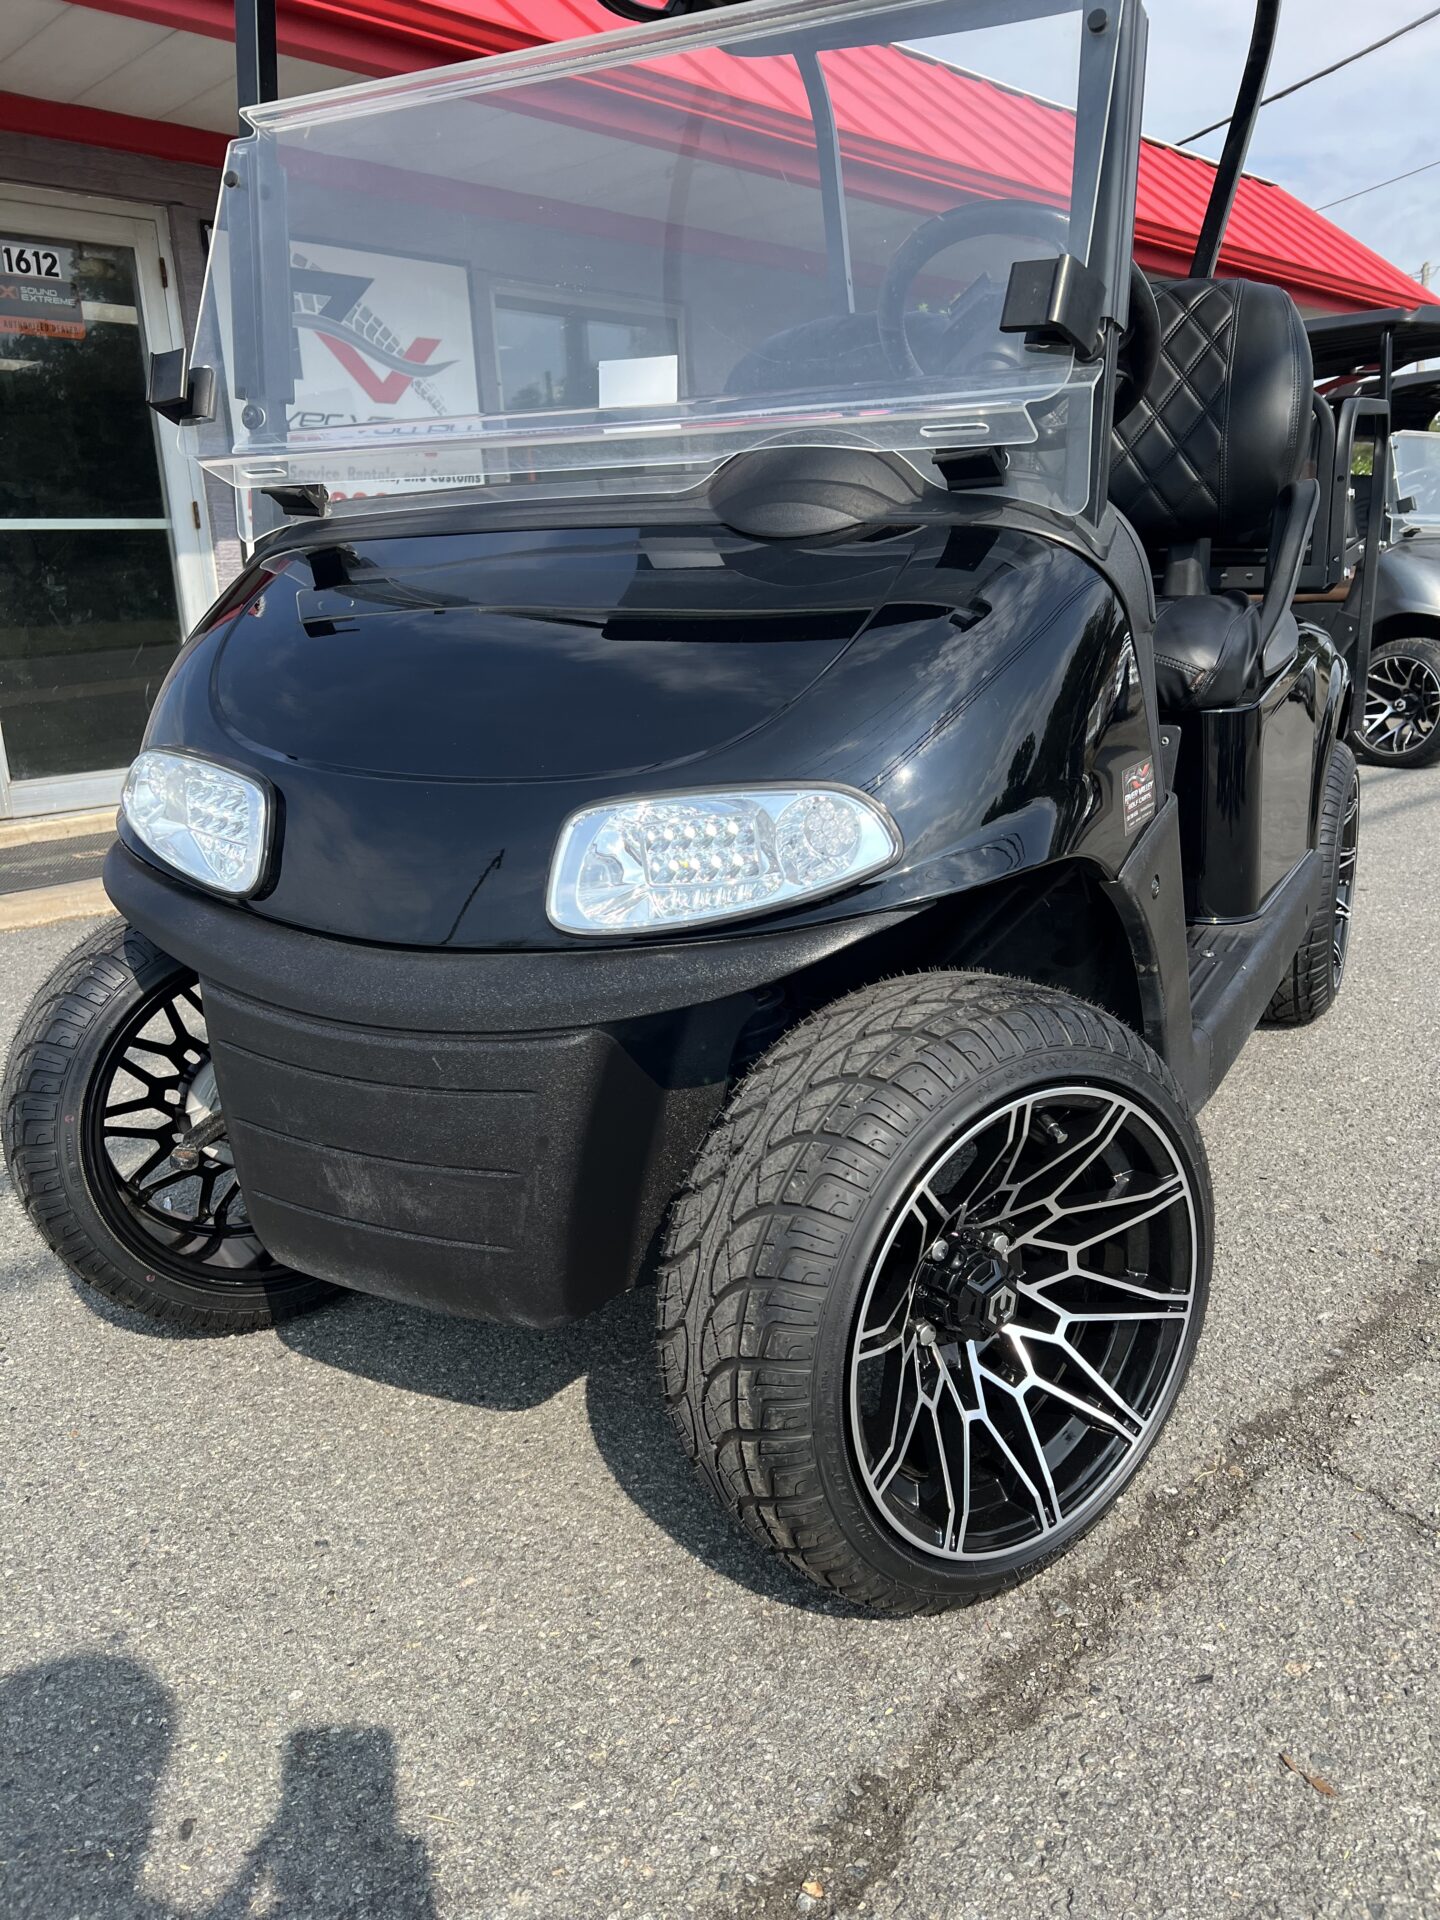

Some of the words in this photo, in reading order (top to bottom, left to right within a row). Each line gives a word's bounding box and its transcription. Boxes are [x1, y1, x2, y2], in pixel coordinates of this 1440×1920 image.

[3, 247, 60, 278] 1612
[20, 286, 57, 297] SOUND
[21, 293, 76, 306] EXTREME
